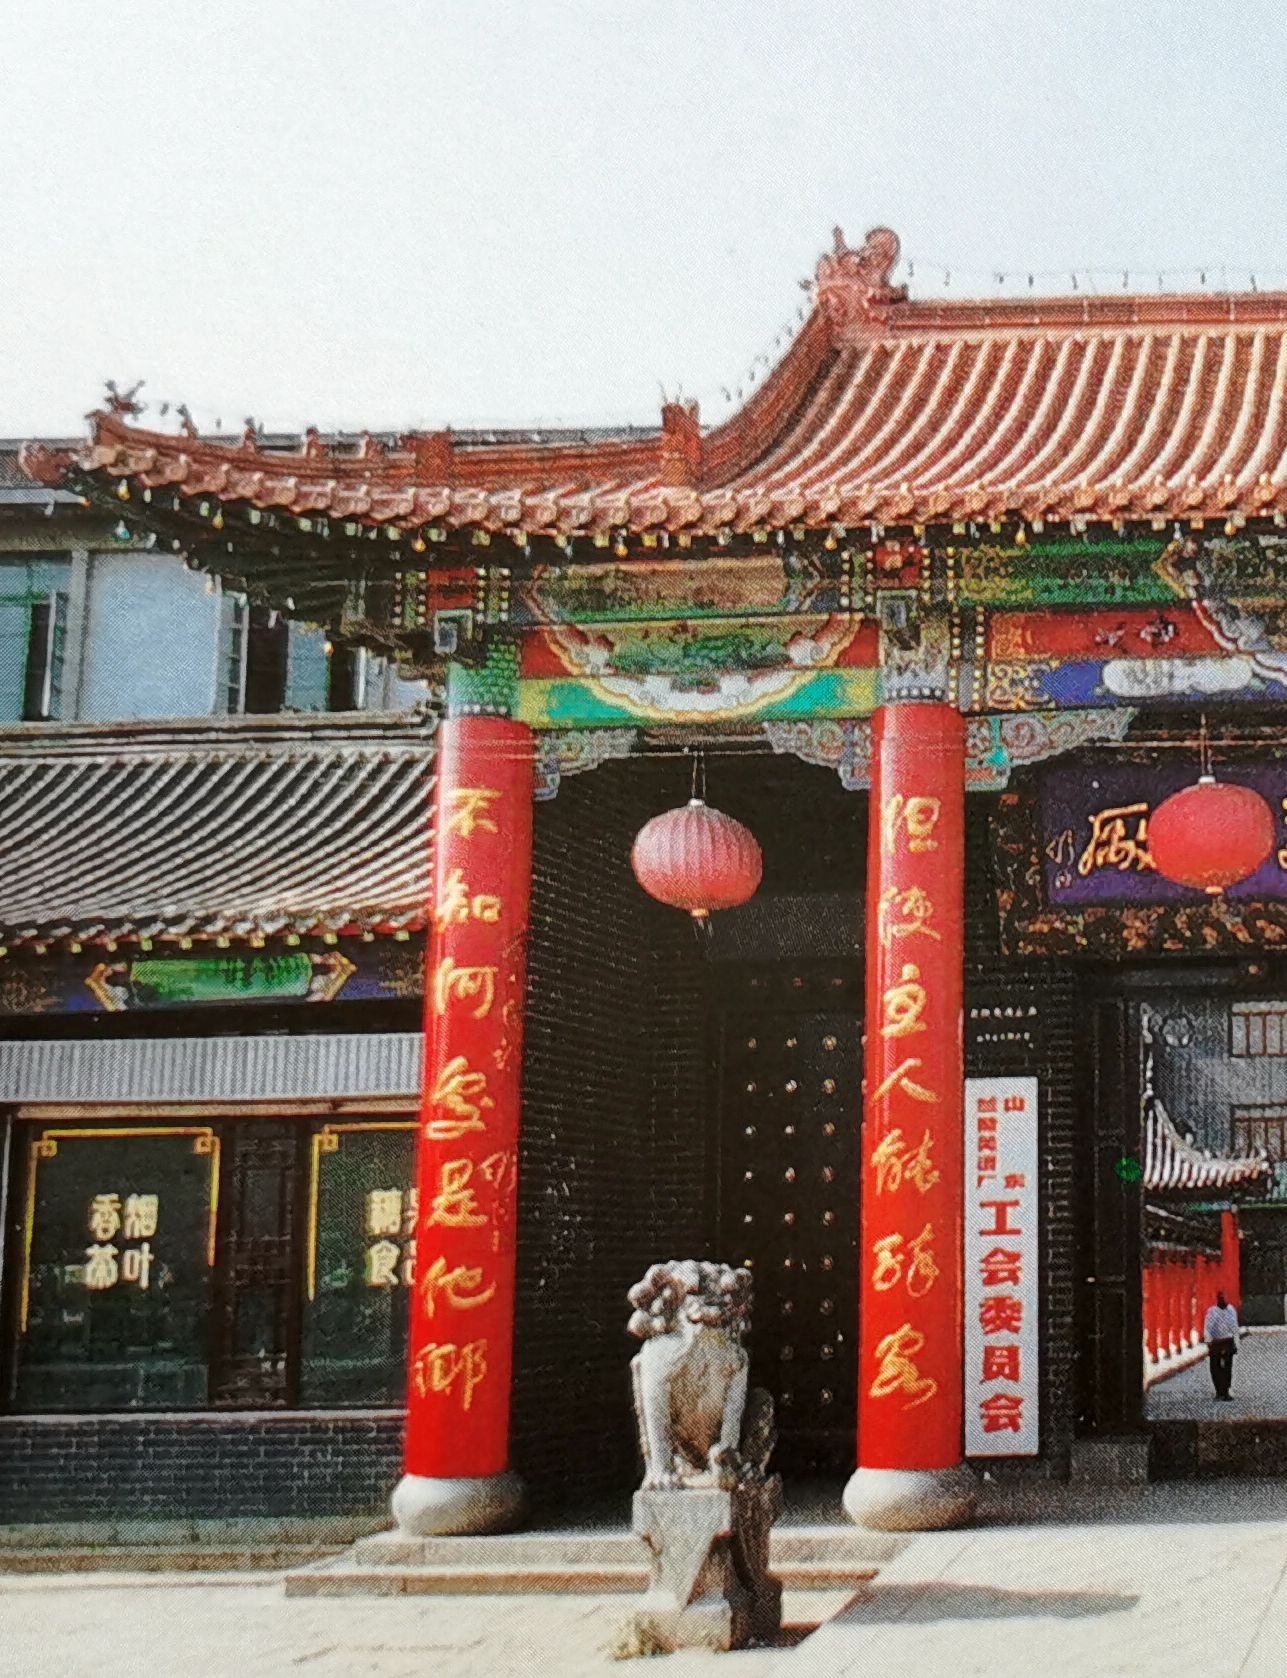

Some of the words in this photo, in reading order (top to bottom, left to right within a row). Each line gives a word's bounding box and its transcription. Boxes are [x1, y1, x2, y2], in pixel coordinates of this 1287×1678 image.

[364, 1239, 416, 1287] 食
[978, 1199, 1025, 1434] 工会委员会
